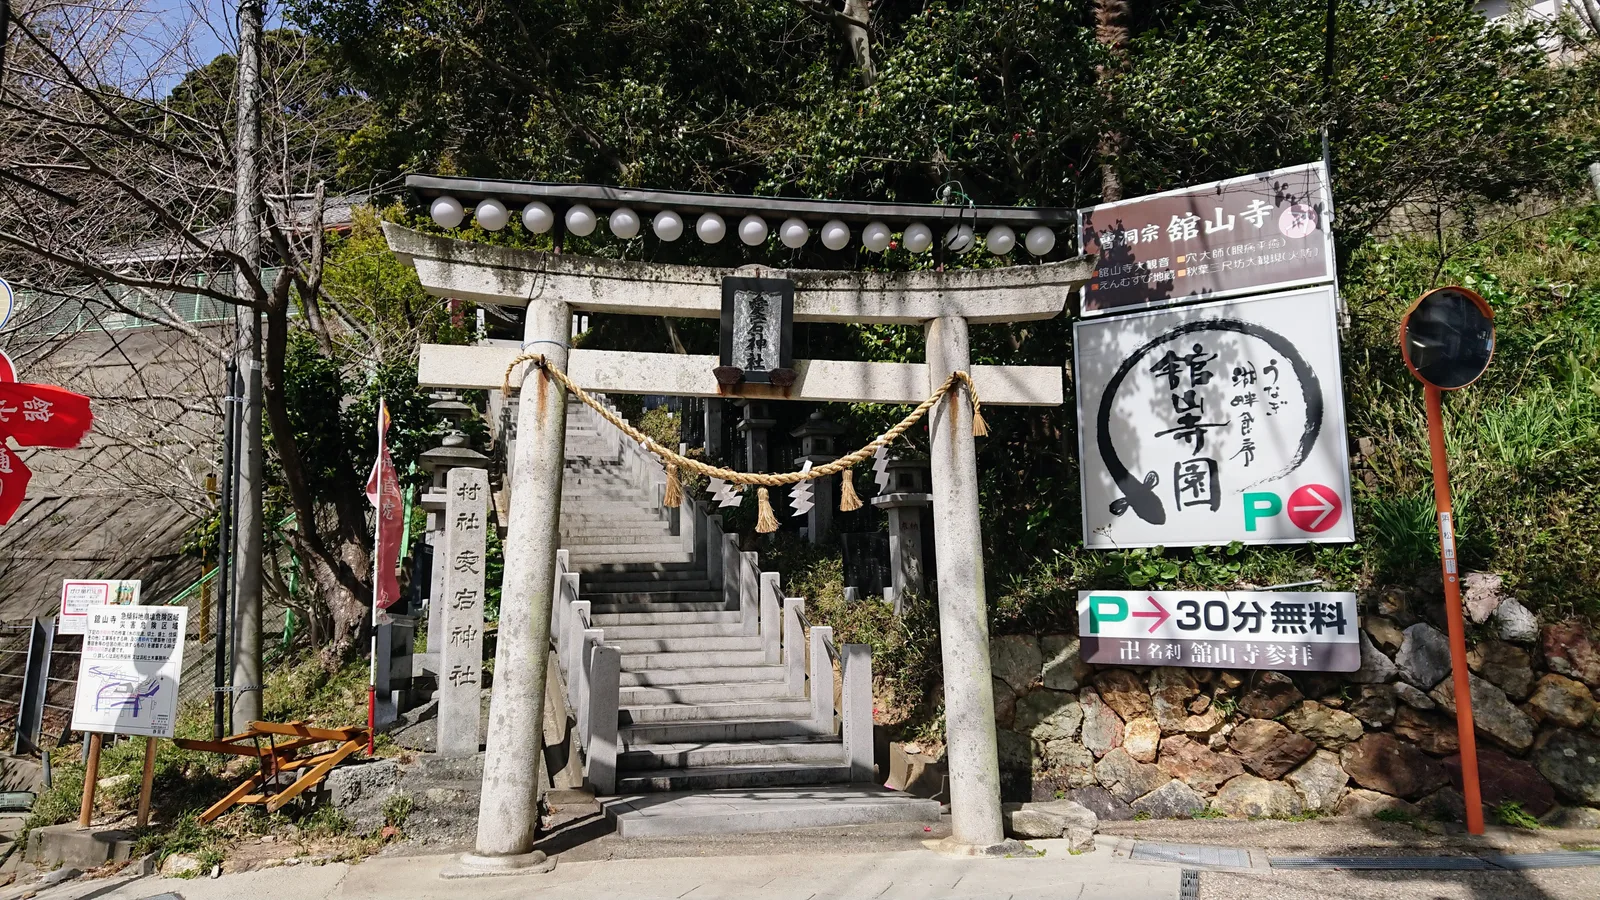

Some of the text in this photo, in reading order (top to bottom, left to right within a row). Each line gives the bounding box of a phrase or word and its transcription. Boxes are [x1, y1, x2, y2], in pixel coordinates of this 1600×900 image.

[1099, 224, 1160, 250] 曹洞宗
[1263, 359, 1288, 416] うなぎ
[1242, 491, 1283, 532] P
[1089, 595, 1348, 635] P 30分無料
[1147, 643, 1182, 660] 名刹
